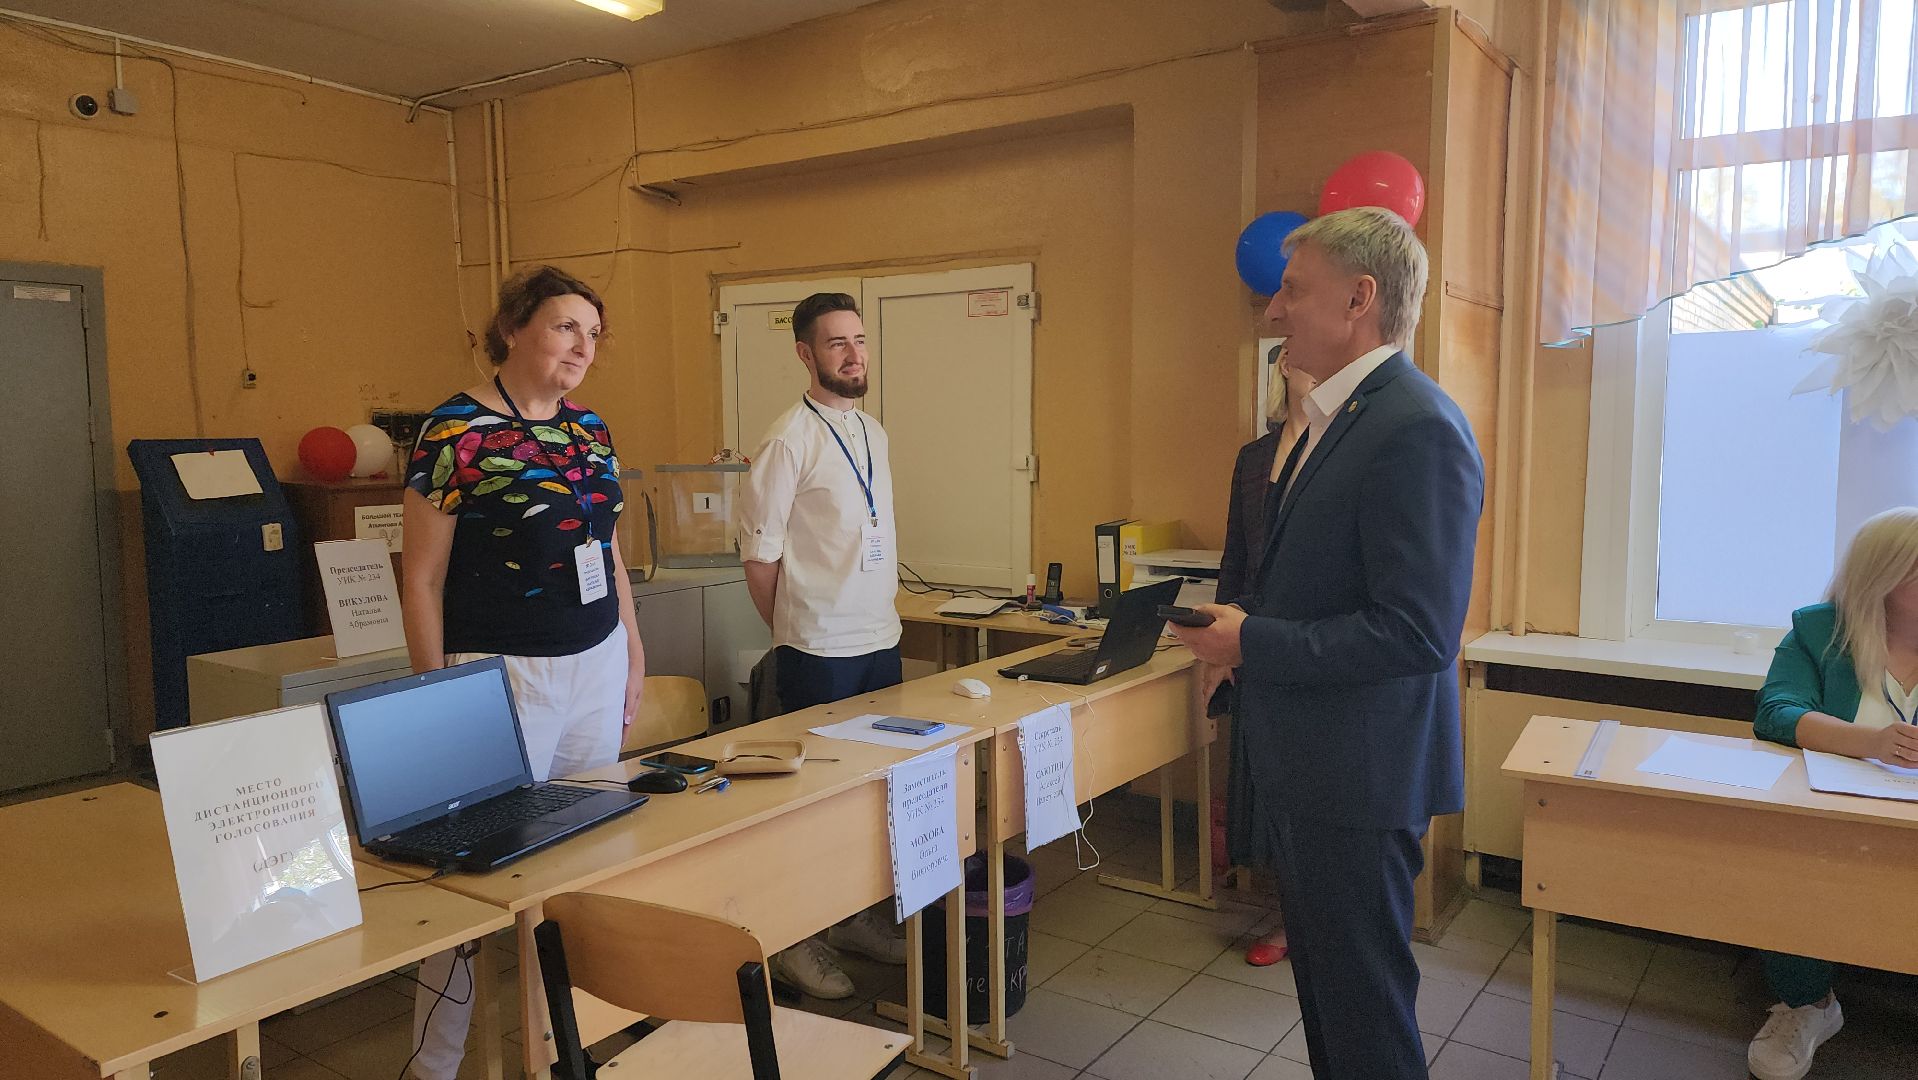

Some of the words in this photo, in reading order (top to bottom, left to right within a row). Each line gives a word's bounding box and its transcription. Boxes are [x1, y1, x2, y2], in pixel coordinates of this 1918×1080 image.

[704, 496, 711, 510] 1
[329, 563, 384, 576] Председатель
[337, 576, 356, 586] УИК
[368, 573, 381, 581] 234
[338, 594, 388, 608] ВИКУЛОВА
[351, 608, 381, 618] Наталья
[349, 617, 389, 630] Абрамовна
[236, 777, 283, 797] МЕСТО
[903, 769, 947, 794] Заместитель
[194, 780, 325, 822] ДИСТАНЦИОННОГО
[902, 782, 948, 810] председателя
[208, 795, 317, 832] ЭЛЕКТРОННОГО
[447, 801, 461, 810] acer
[906, 805, 924, 822] УИК
[214, 809, 316, 843] ГОЛОСОВАНИЯ
[910, 825, 945, 849] МОХОВА
[919, 844, 939, 860] Ольга
[253, 851, 295, 873] (ДЭГ)
